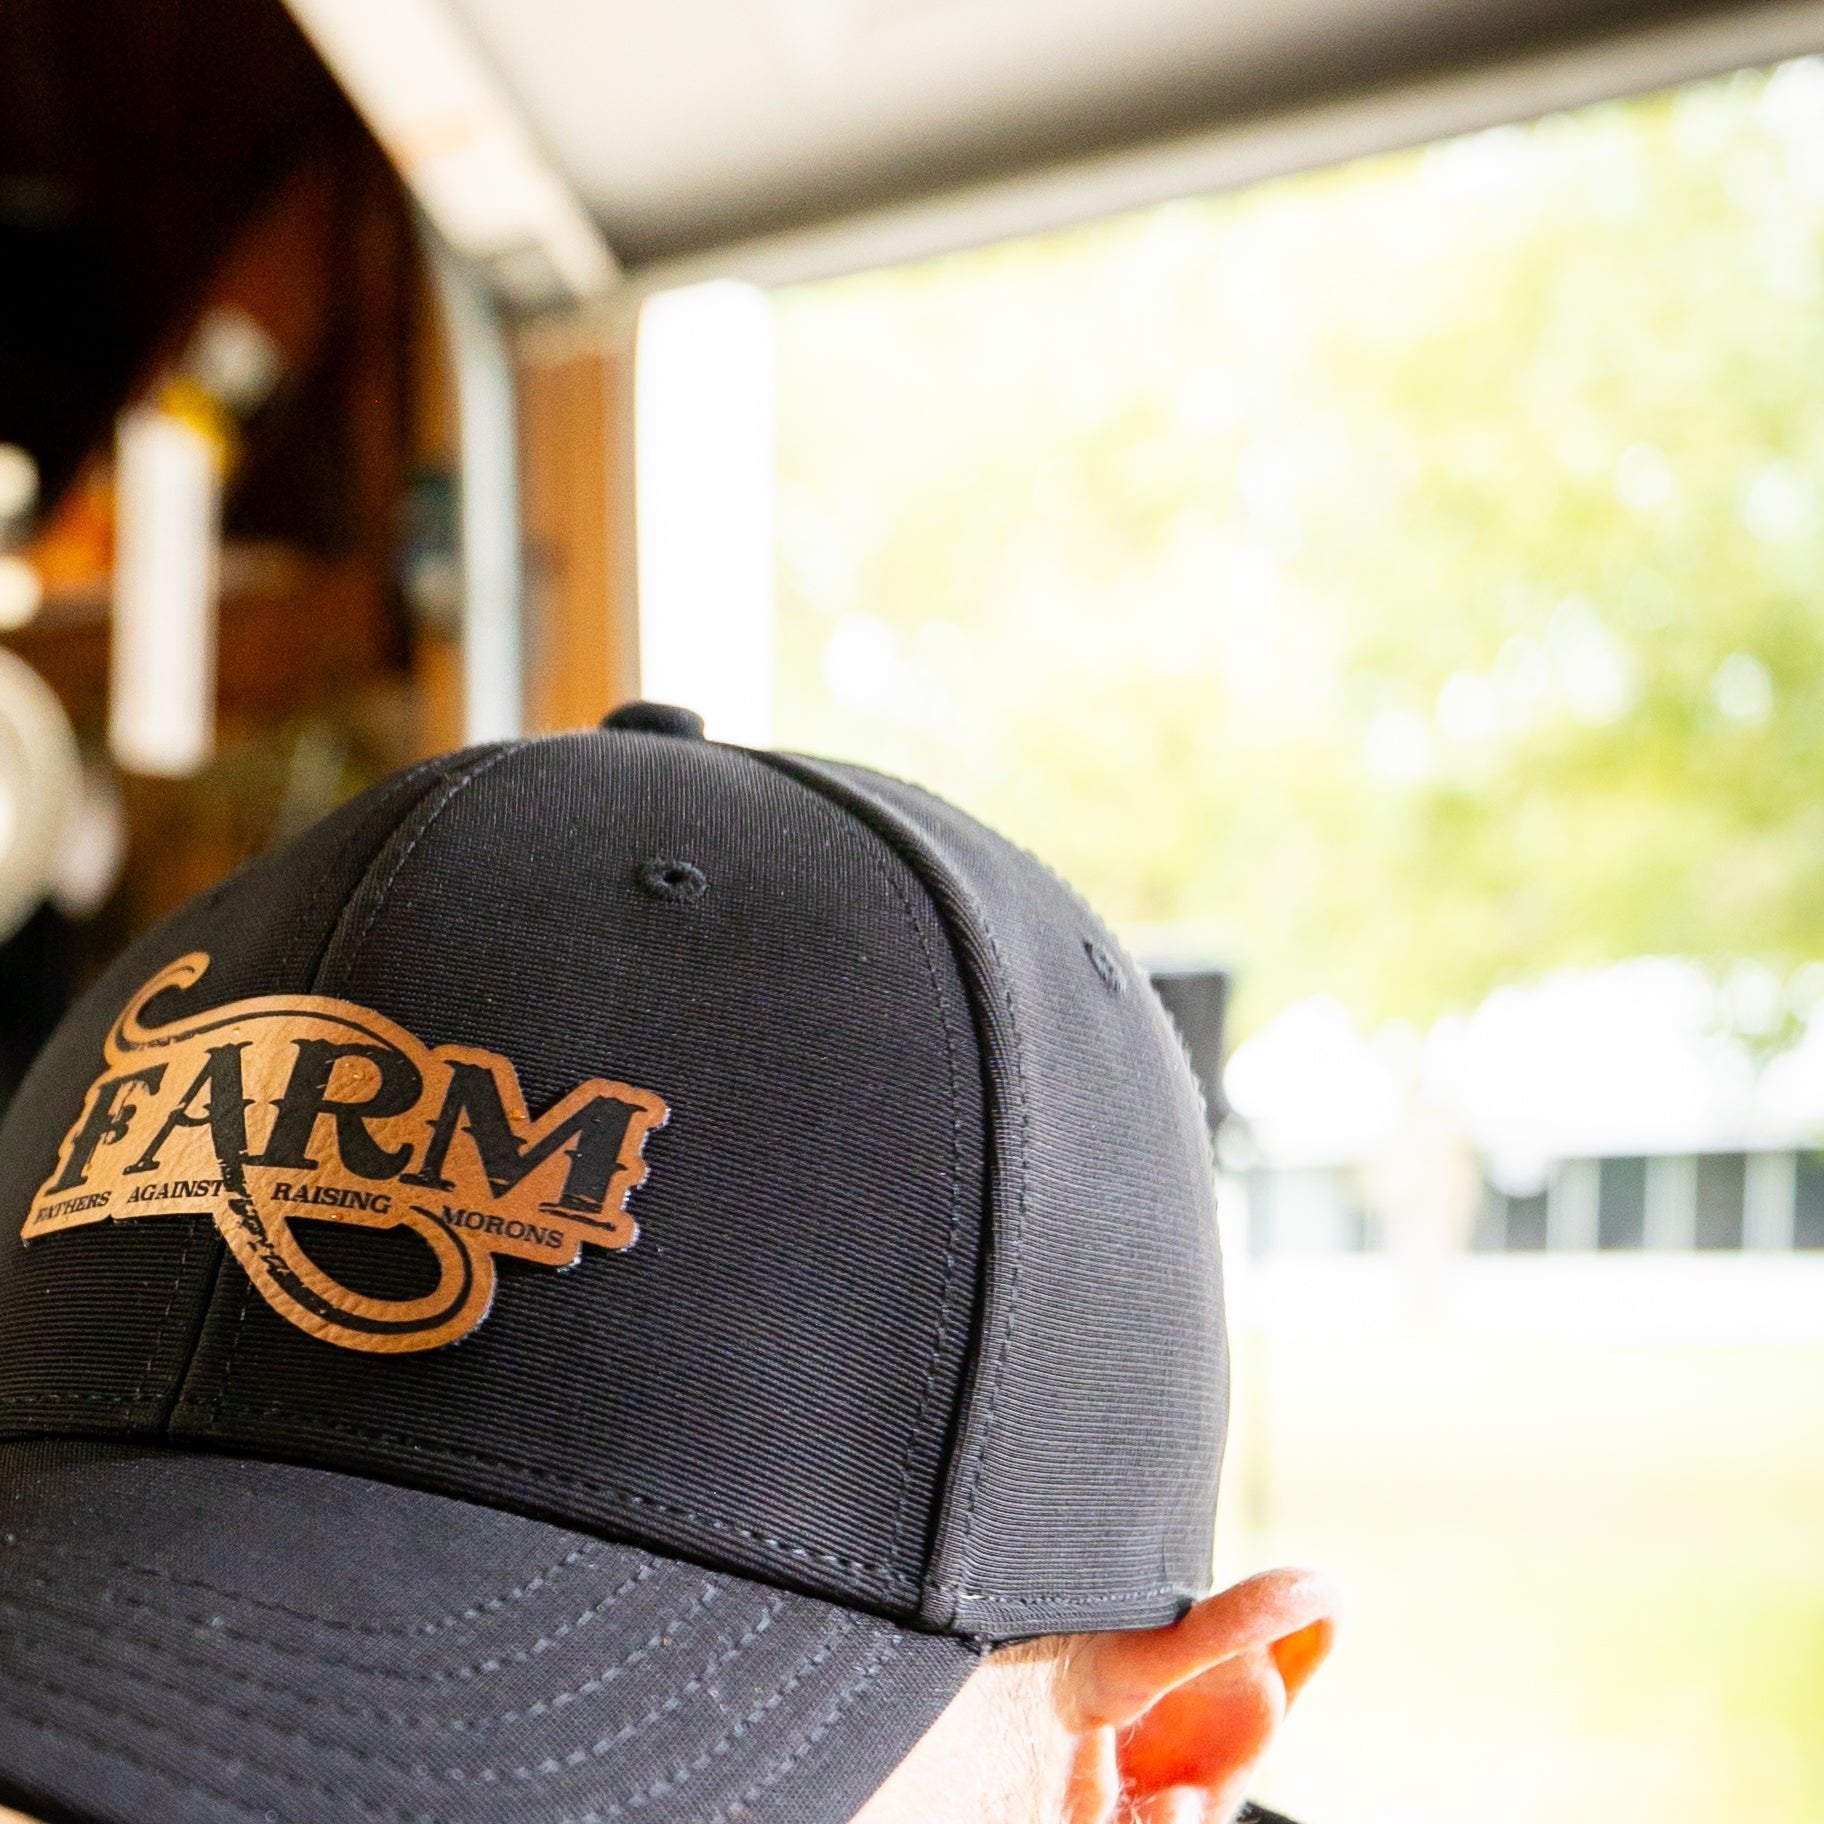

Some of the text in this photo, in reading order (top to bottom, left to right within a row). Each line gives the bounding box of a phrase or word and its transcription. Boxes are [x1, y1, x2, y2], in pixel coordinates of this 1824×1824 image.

[44, 1038, 648, 1232] FARM
[33, 1179, 565, 1249] FATHERS AGAINST RAISING MORONS
